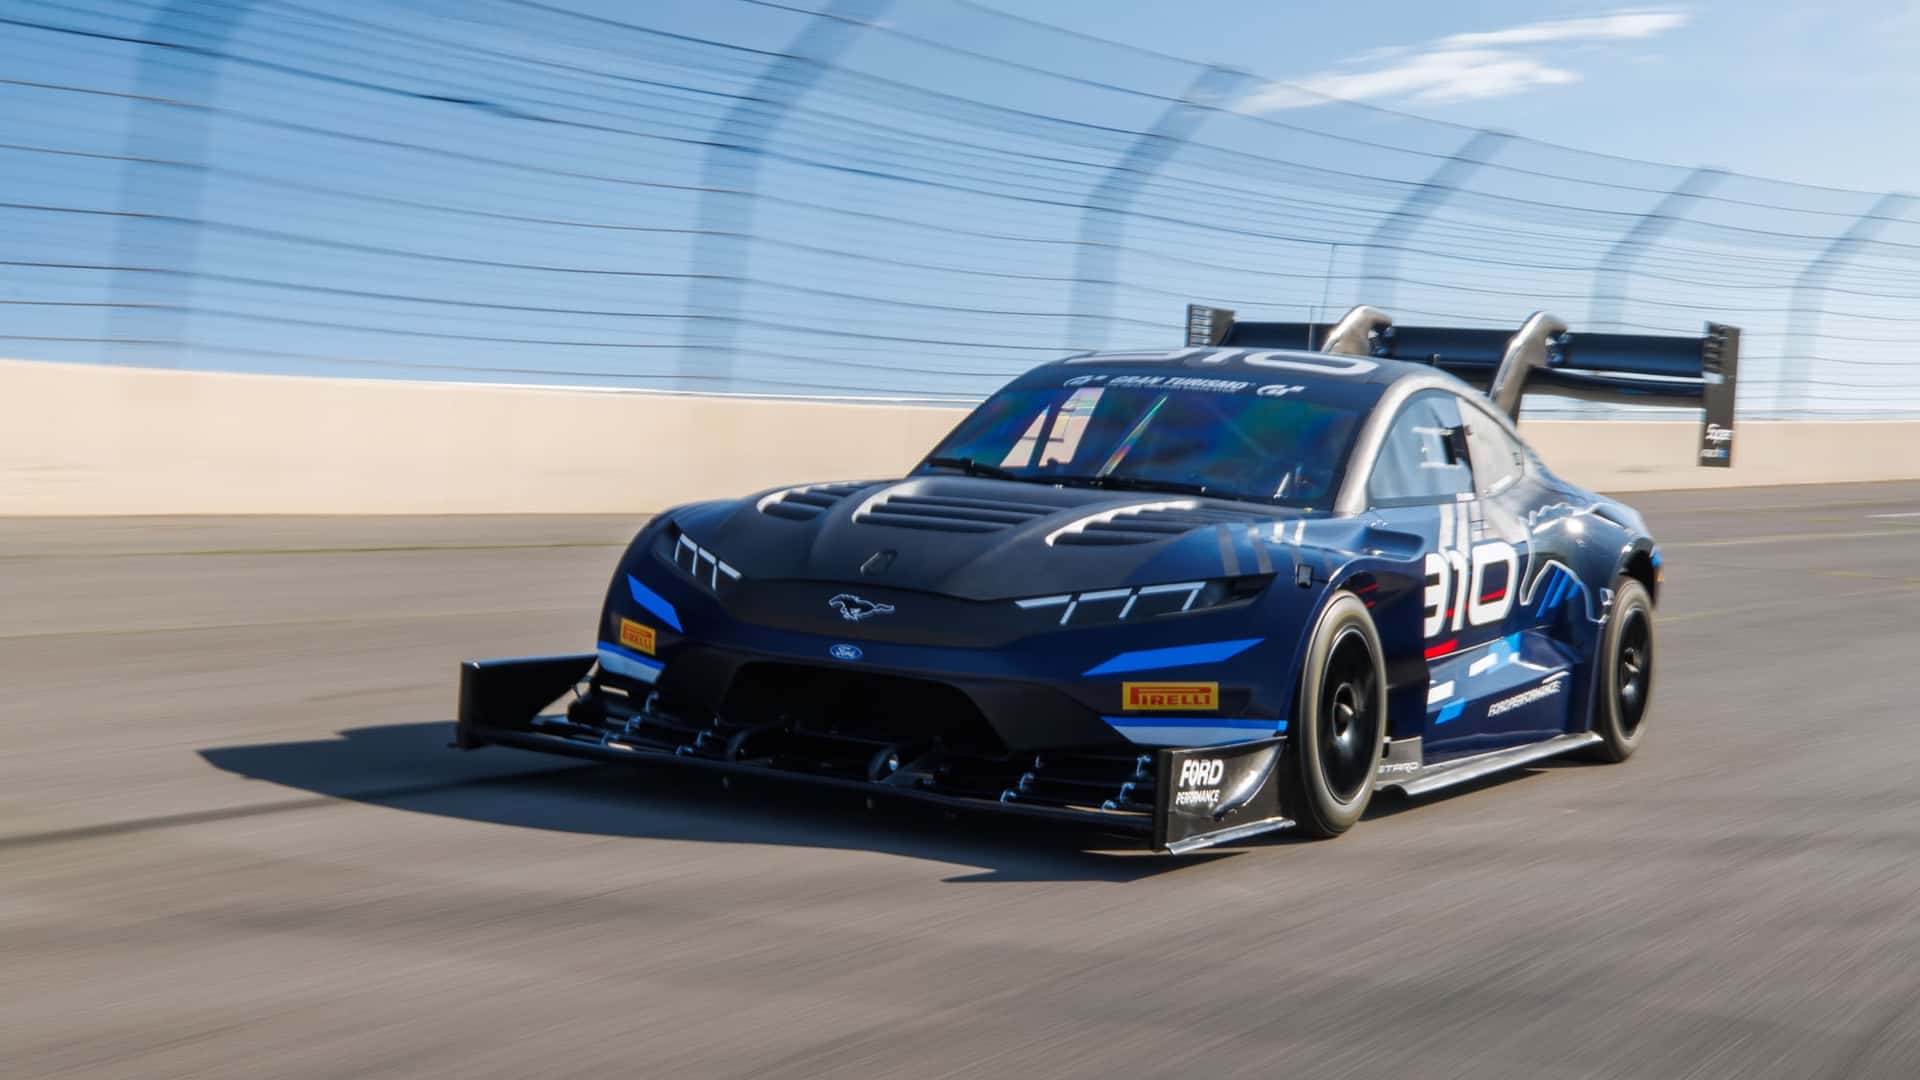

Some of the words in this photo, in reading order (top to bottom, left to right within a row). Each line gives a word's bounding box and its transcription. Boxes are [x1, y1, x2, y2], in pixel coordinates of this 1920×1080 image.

[622, 622, 653, 650] PIRELLI
[1130, 686, 1212, 705] PIRELLI
[1179, 759, 1224, 787] FORD
